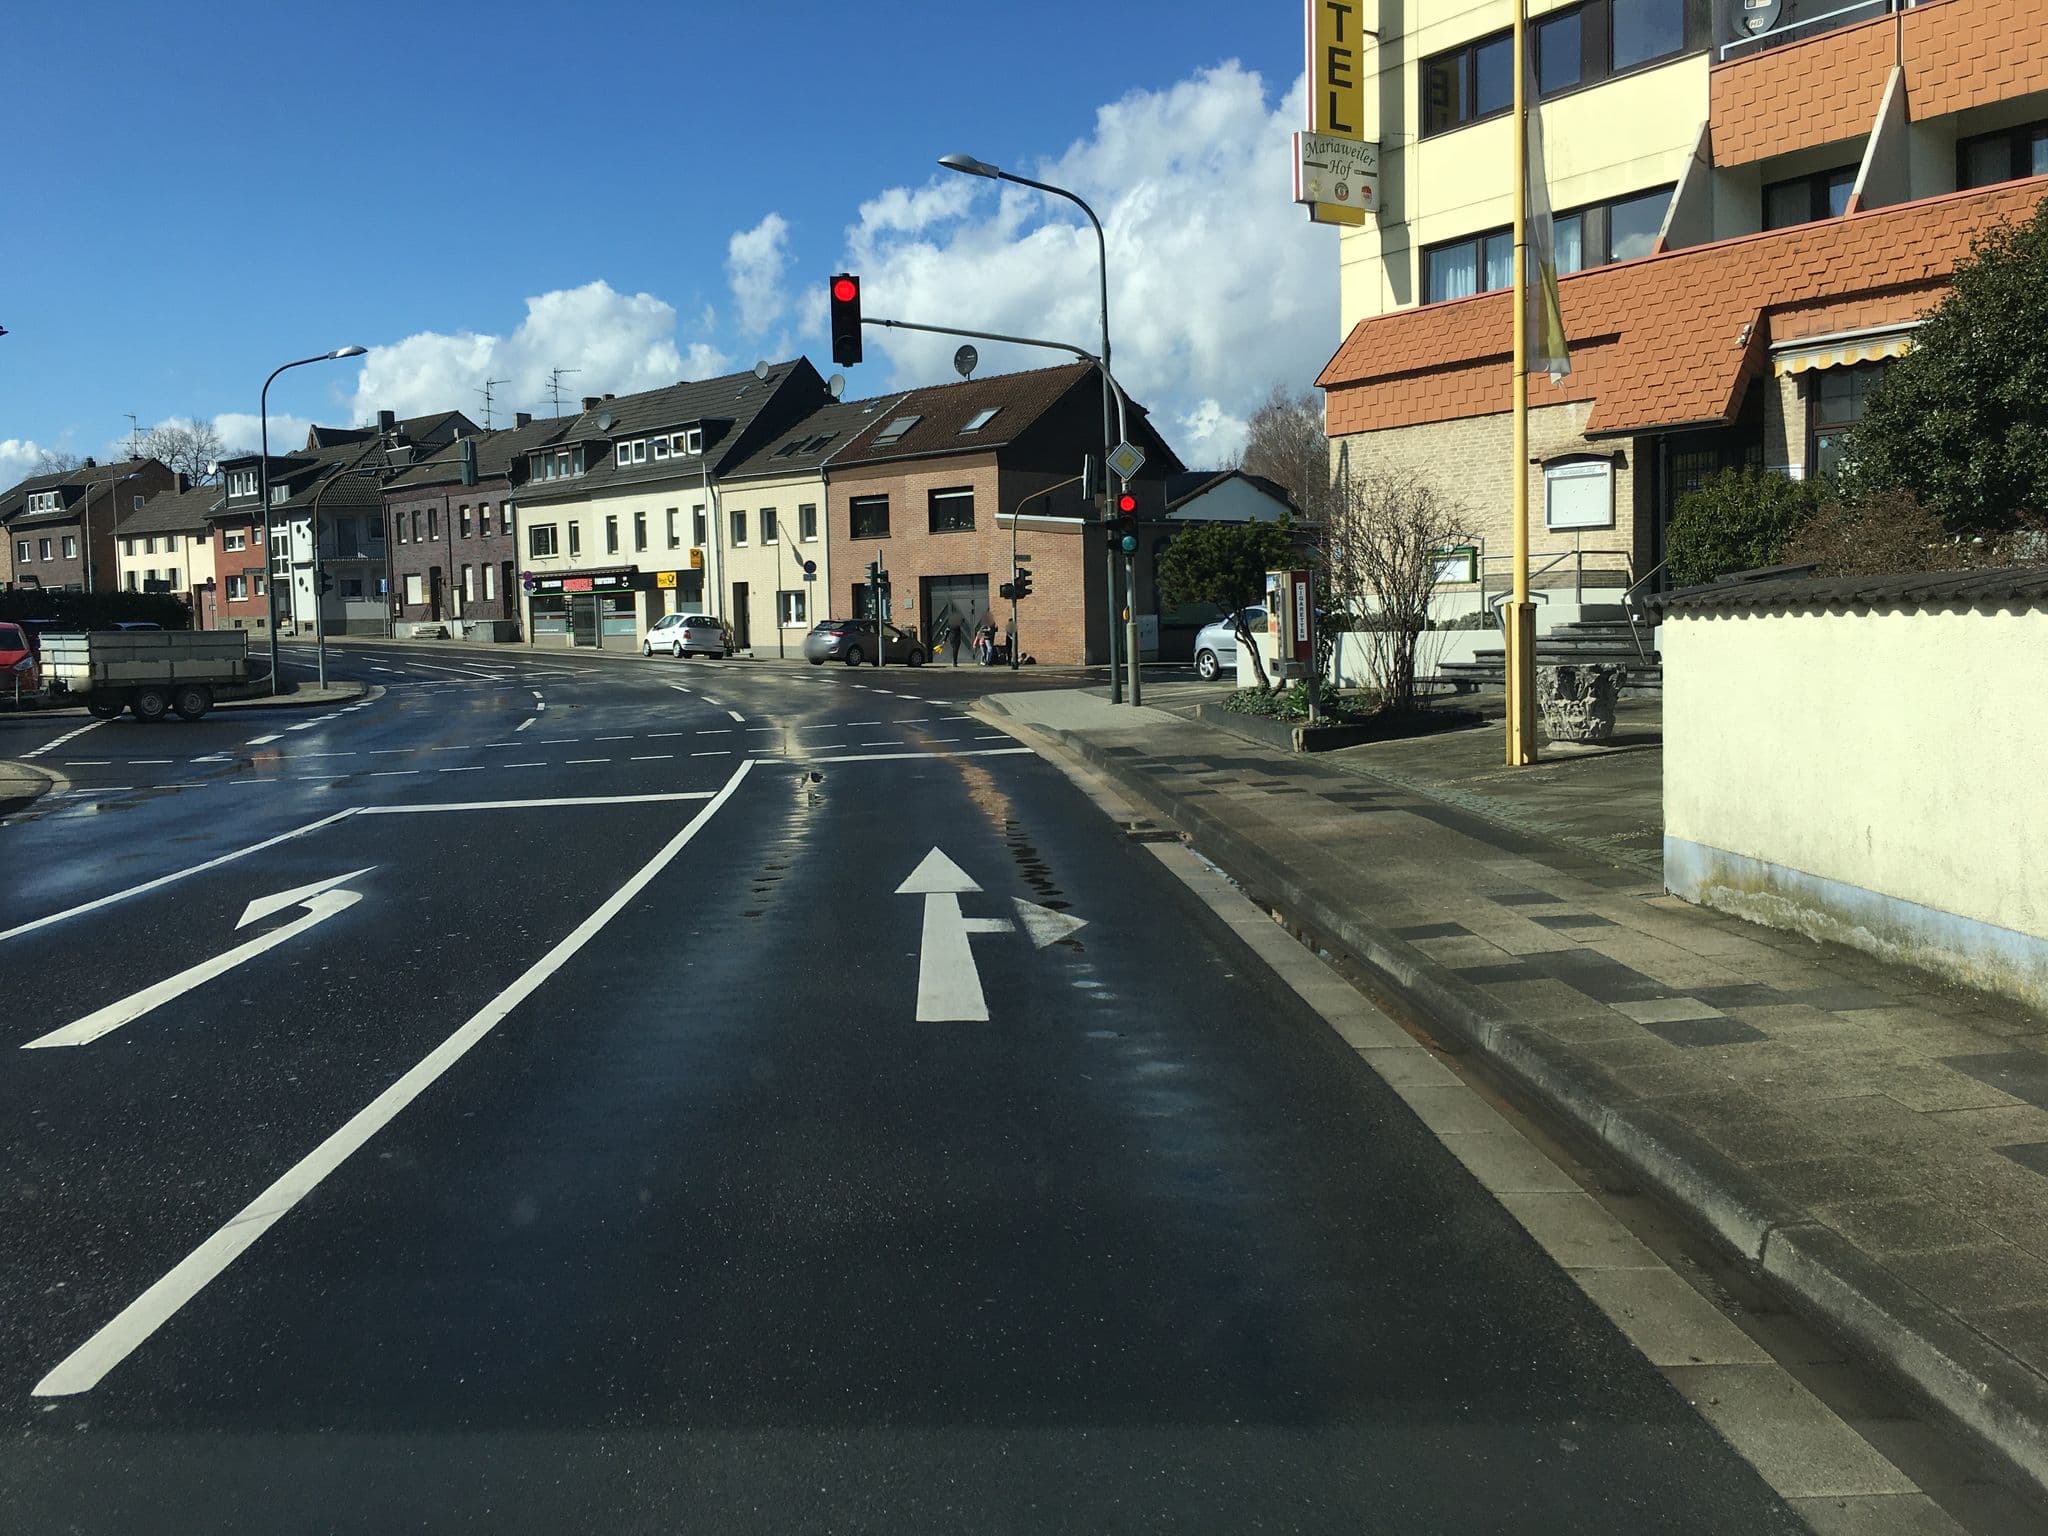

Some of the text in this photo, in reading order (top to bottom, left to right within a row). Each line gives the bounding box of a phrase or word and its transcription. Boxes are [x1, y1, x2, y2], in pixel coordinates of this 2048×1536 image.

[1326, 1, 1353, 133] TEL
[1305, 138, 1376, 167] Mariaweiler
[1329, 159, 1354, 181] Hof
